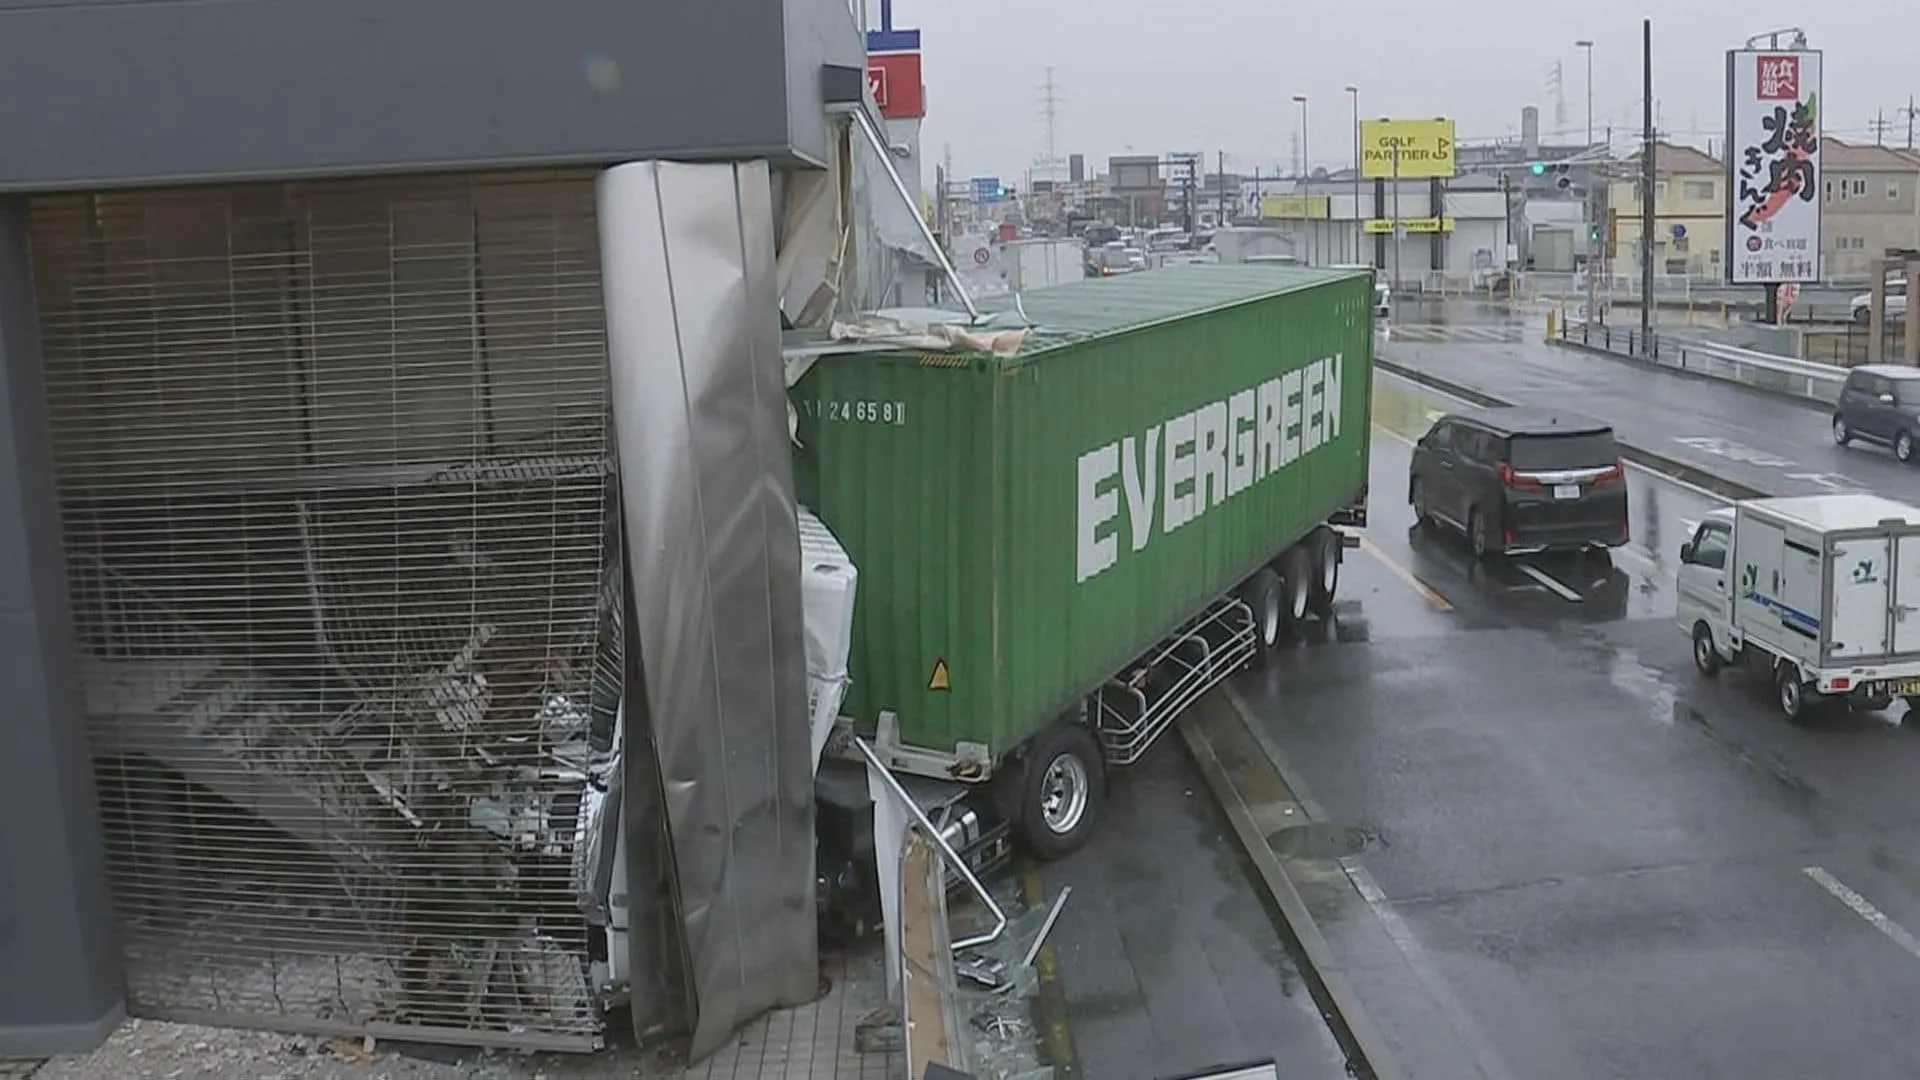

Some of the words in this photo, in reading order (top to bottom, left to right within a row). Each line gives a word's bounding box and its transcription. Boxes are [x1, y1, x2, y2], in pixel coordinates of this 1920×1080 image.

[1379, 136, 1416, 148] GOLF
[1739, 146, 1767, 231] きんぐ
[1761, 101, 1817, 202] 焼肉
[1077, 352, 1342, 583] EVERGREEN
